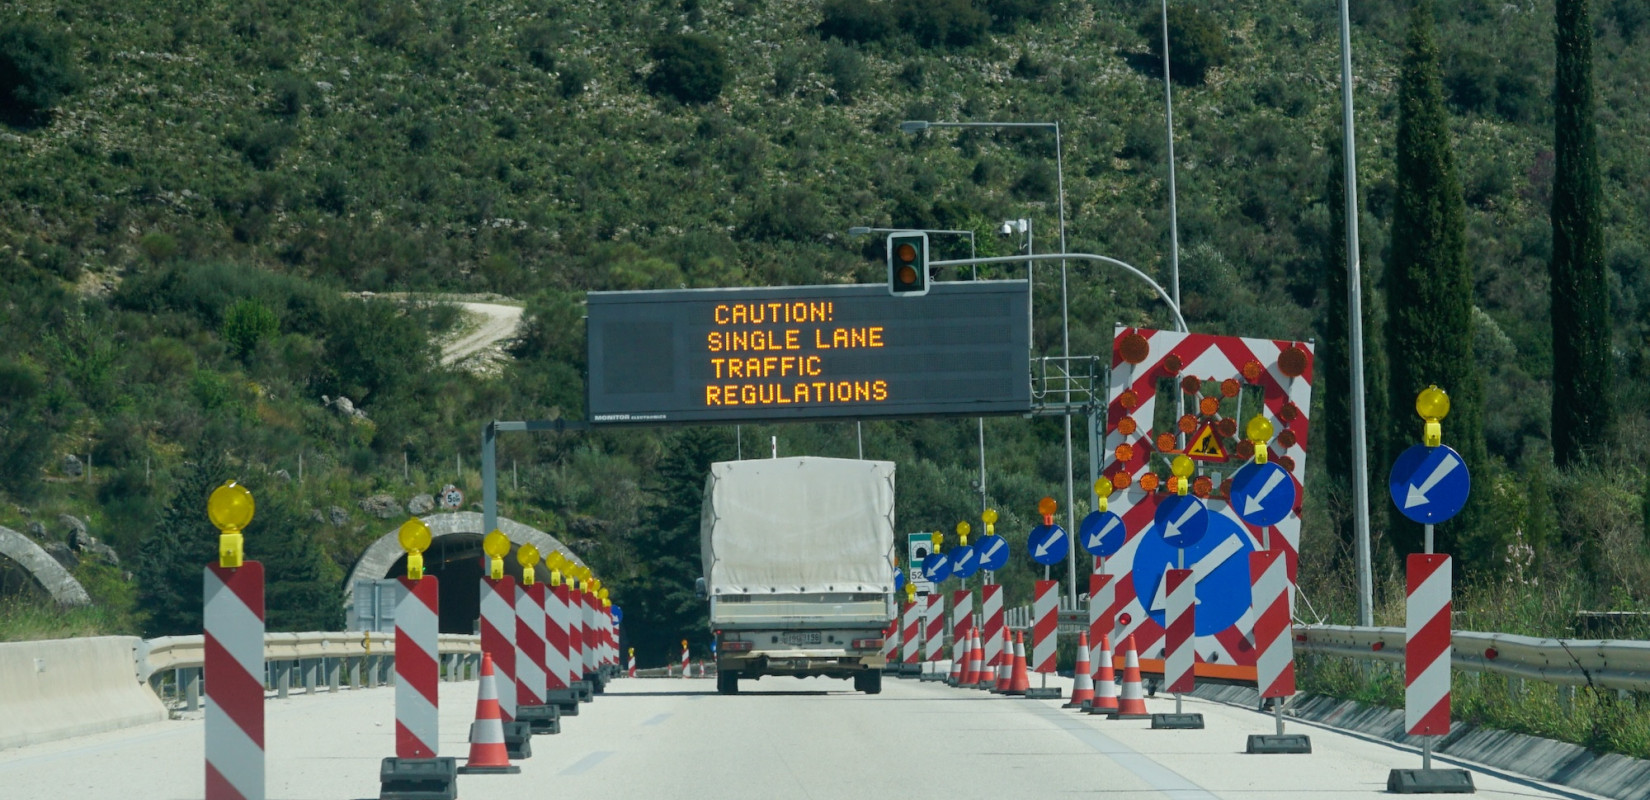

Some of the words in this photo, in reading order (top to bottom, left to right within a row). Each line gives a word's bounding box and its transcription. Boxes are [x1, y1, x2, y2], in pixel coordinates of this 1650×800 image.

[715, 302, 832, 324] CAUTION!
[708, 330, 800, 351] SINGLE
[816, 327, 884, 349] LANE
[711, 356, 821, 378] TRAFFIC
[706, 381, 888, 405] REGULATIONS
[911, 571, 923, 580] 52
